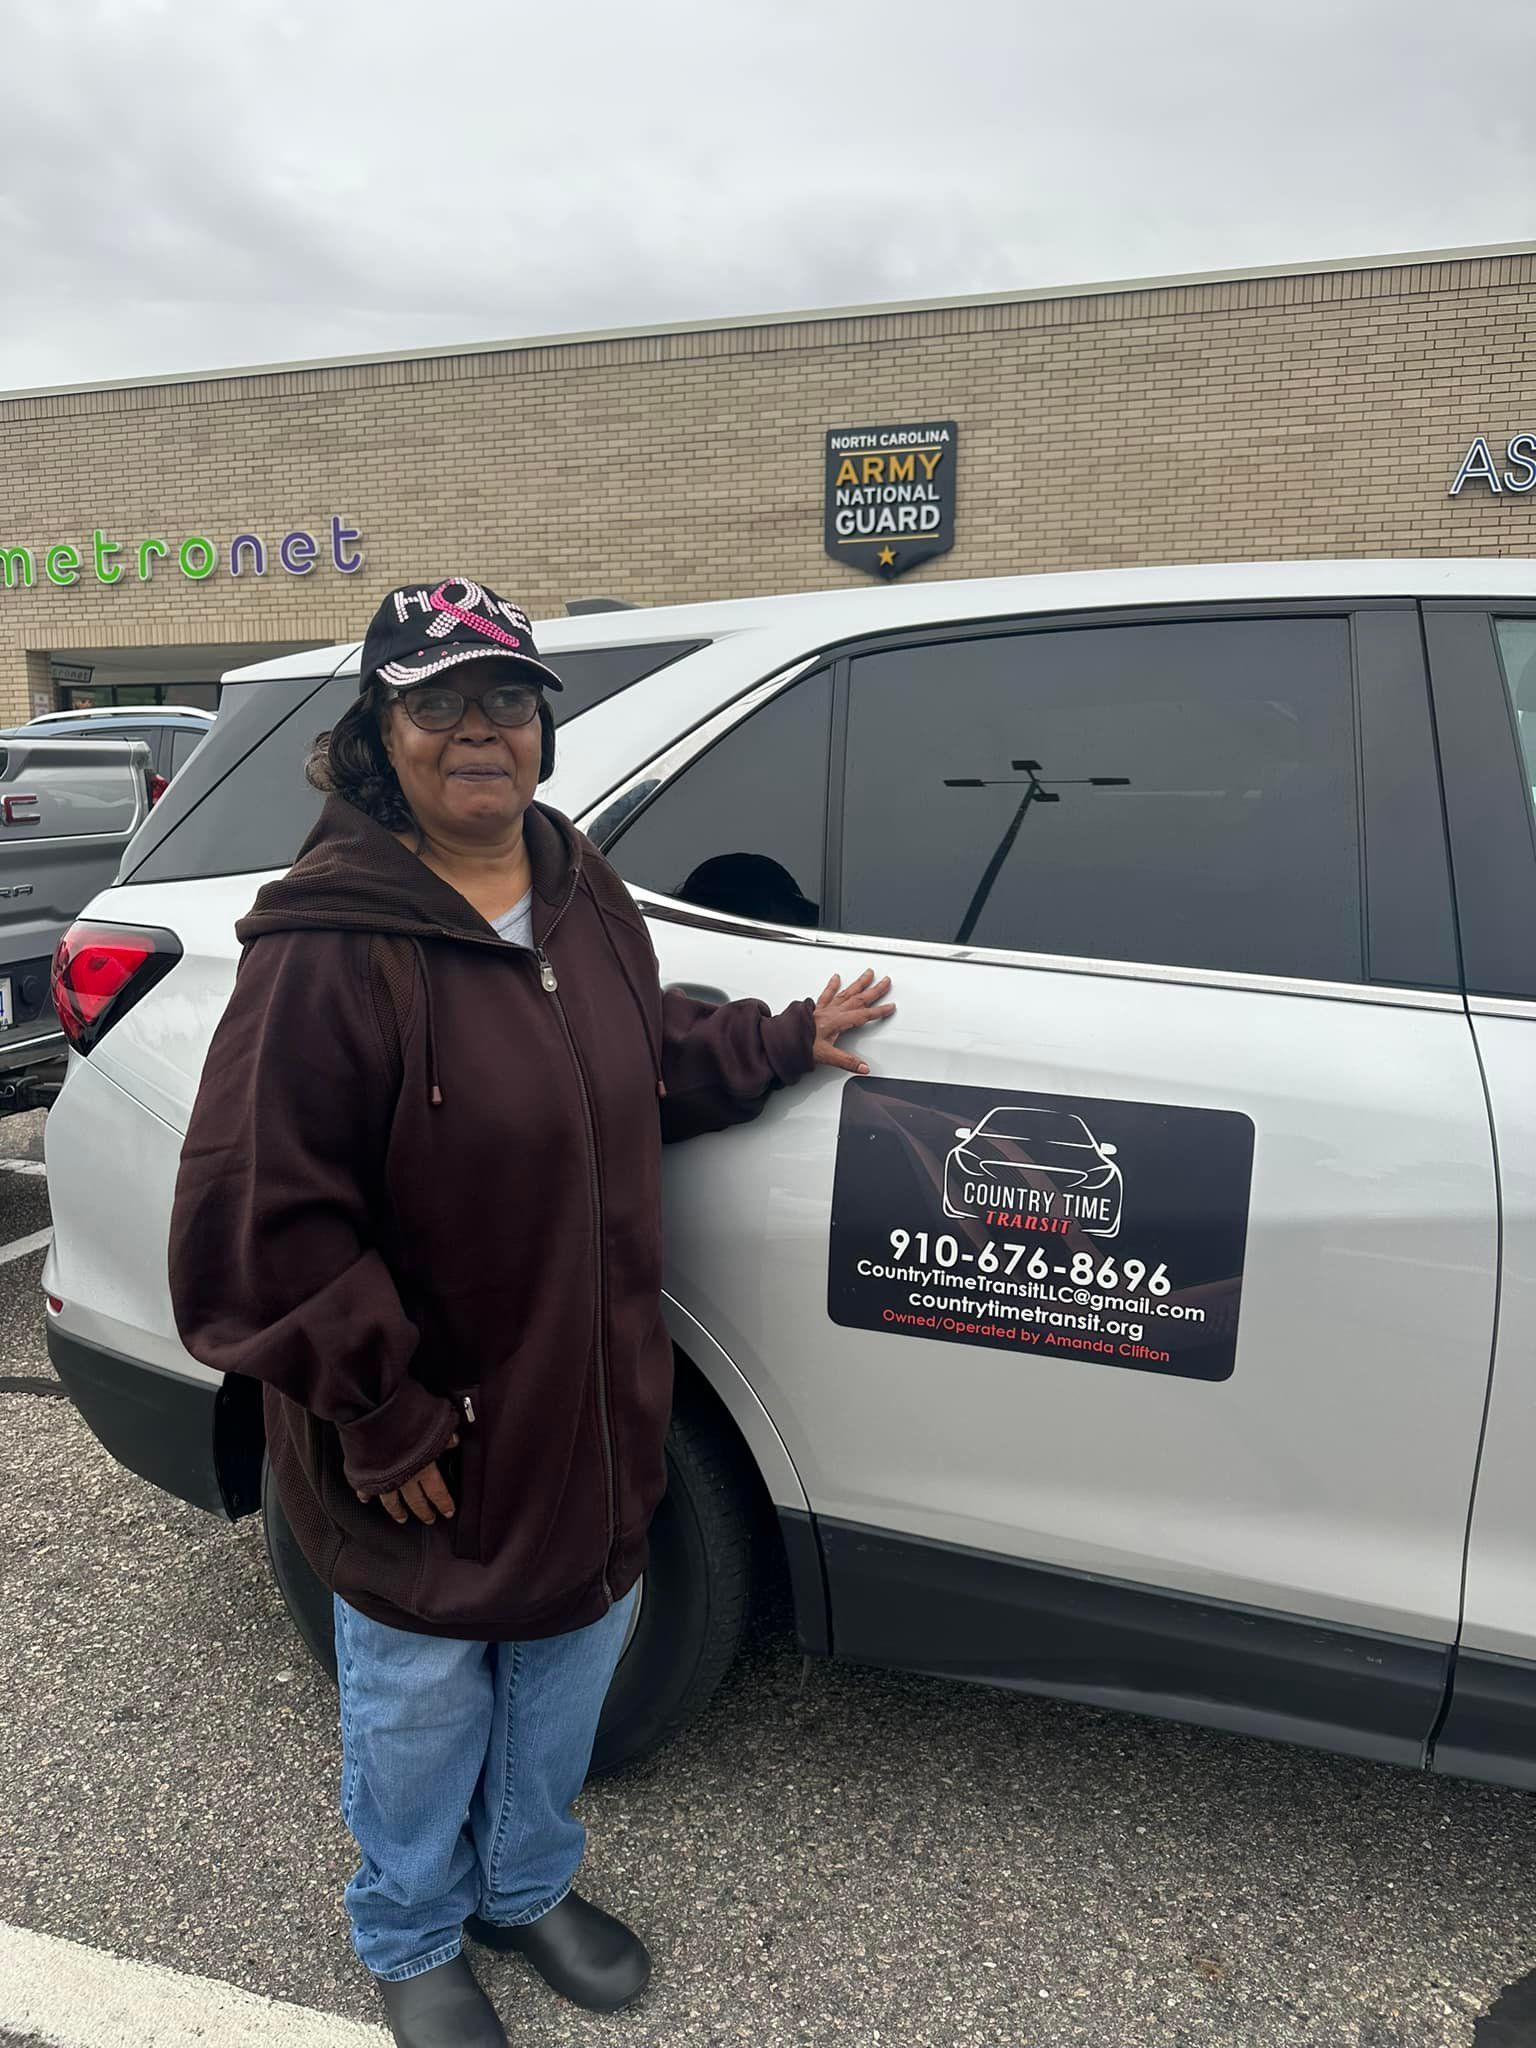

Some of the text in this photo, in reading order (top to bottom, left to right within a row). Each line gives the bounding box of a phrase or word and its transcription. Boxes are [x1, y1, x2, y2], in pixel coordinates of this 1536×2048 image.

[831, 429, 950, 450] NORTH CAROLINA
[1448, 432, 1536, 495] AS
[835, 451, 943, 487] ARMY
[835, 504, 941, 536] GUARD
[836, 483, 940, 507] NATIONAL
[0, 514, 364, 589] metronet
[964, 1182, 1111, 1221] COUNTRY TIME
[889, 1228, 1171, 1297] 910-676-8696
[856, 1259, 1206, 1322] CountryTimeTransitLLC@gmail.com
[882, 1308, 1170, 1362] Owned/Operated by Amanda Clifton
[908, 1292, 1144, 1342] countrytimetransit.org
